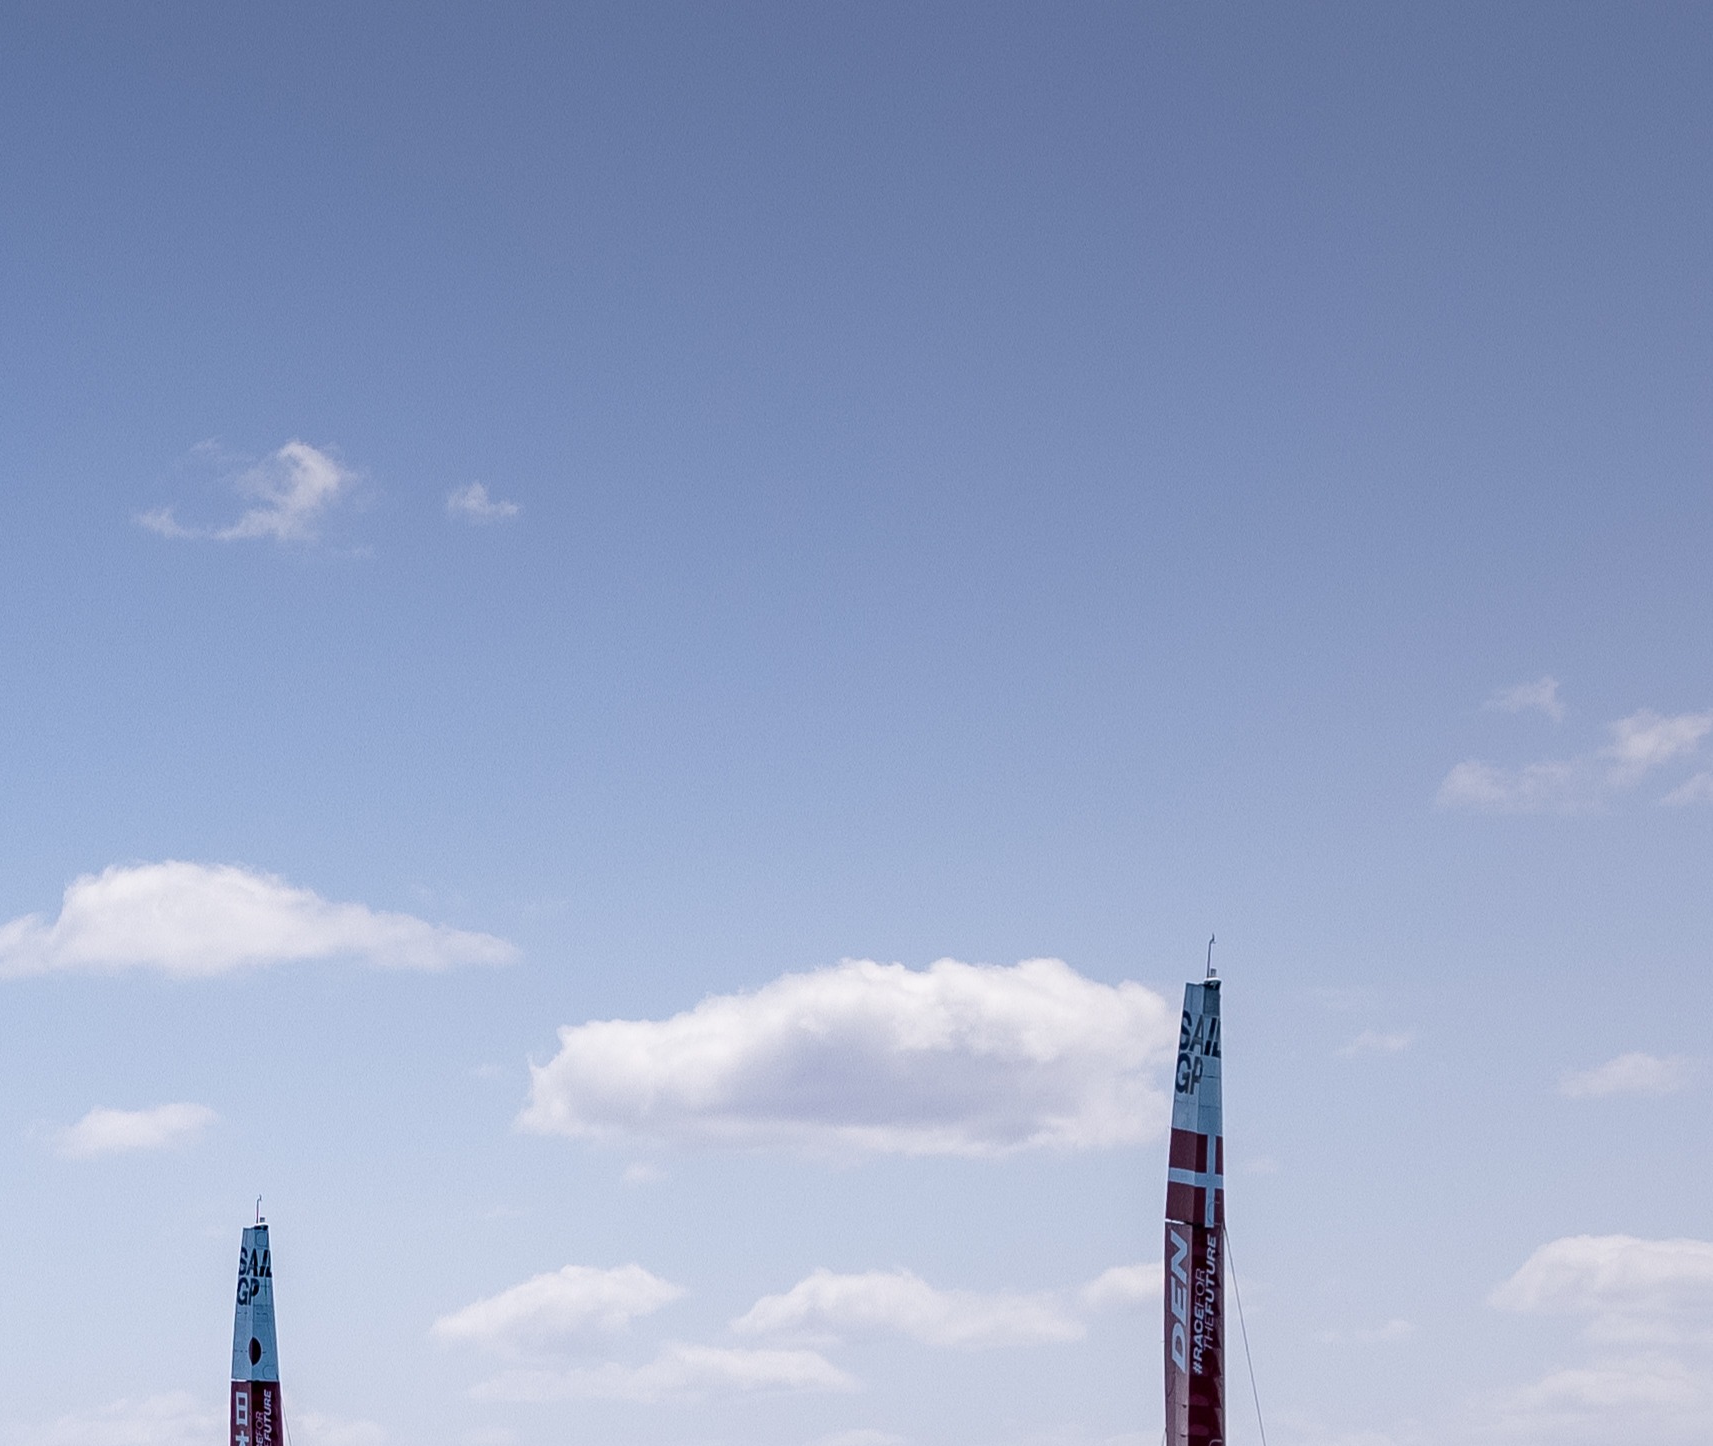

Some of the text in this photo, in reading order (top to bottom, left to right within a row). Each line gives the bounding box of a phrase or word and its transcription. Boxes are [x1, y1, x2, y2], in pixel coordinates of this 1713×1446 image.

[1175, 1053, 1203, 1095] GP
[236, 1277, 259, 1306] GP
[1170, 1229, 1188, 1374] DEN
[1192, 1268, 1206, 1376] #RACEFOR
[1203, 1233, 1217, 1351] THEFUTURE
